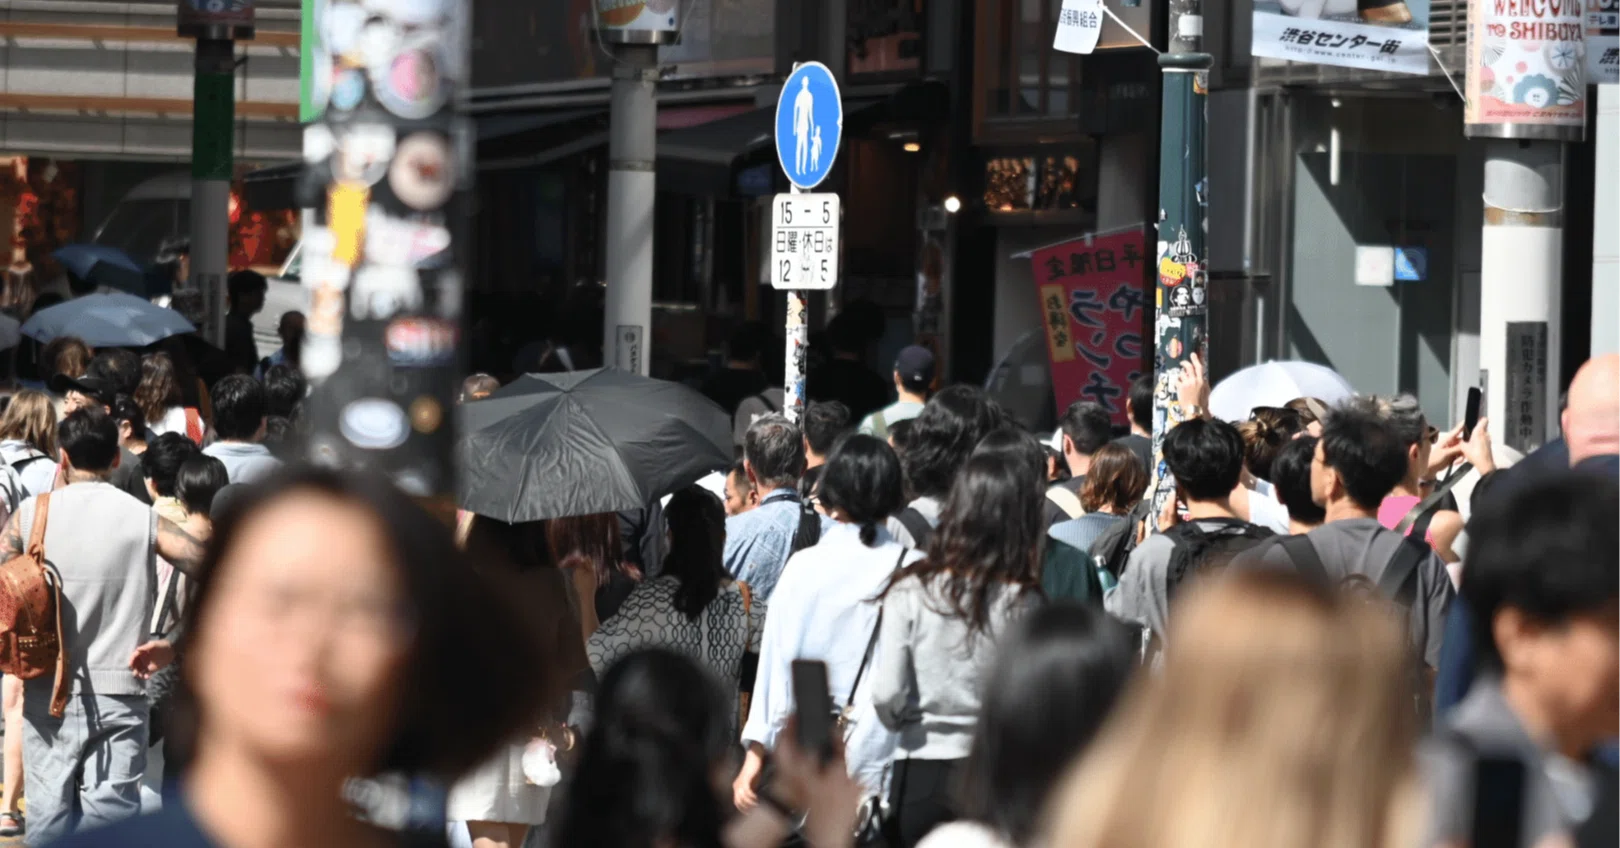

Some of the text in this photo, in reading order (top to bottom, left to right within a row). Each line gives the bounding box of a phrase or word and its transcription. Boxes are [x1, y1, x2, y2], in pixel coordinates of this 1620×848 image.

[1279, 27, 1402, 54] 渋谷センター街
[1509, 21, 1582, 41] SHIBUYA
[781, 201, 793, 224] 15
[822, 201, 830, 224] 5
[779, 259, 791, 282] 12
[820, 259, 828, 282] 5
